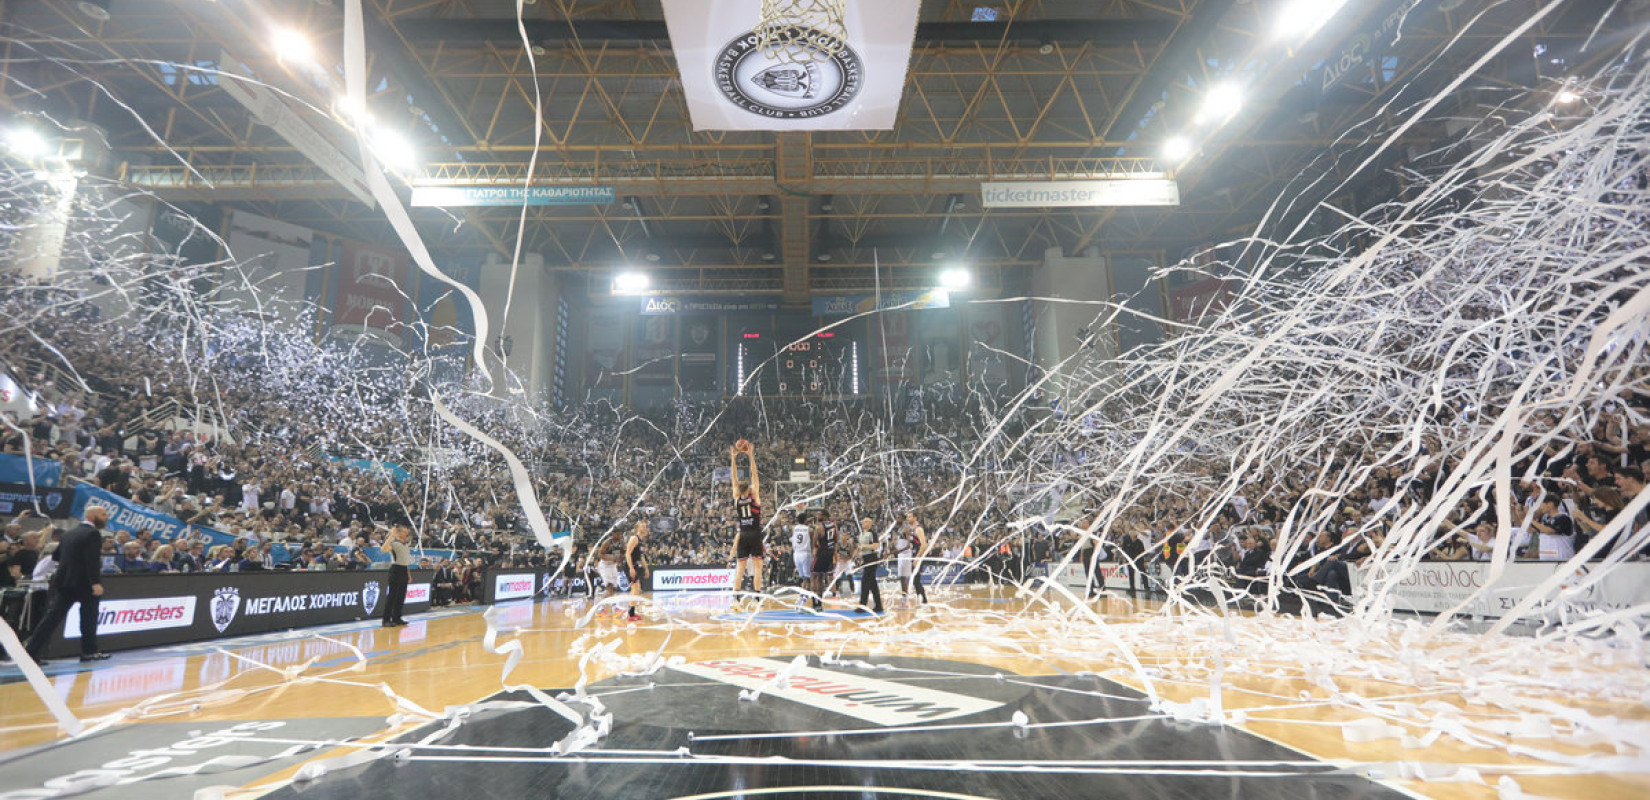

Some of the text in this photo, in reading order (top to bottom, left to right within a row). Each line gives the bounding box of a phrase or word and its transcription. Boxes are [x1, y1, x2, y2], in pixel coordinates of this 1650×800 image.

[718, 49, 747, 106] BASKETBALL
[748, 105, 784, 118] CLUB
[831, 50, 859, 106] BASKETBALL
[799, 105, 833, 118] CLUB
[532, 187, 612, 198] ΚΑΘΑΡΙΟΤΗΤΑΣ
[985, 187, 1095, 203] ticketmaster
[741, 505, 752, 518] 11
[115, 507, 178, 540] EUROPE
[796, 534, 804, 545] 9
[660, 572, 730, 585] winmasters
[245, 591, 359, 615] ΜΕΓΑΛΟΣ ΧΟΡΗΓΟΣ
